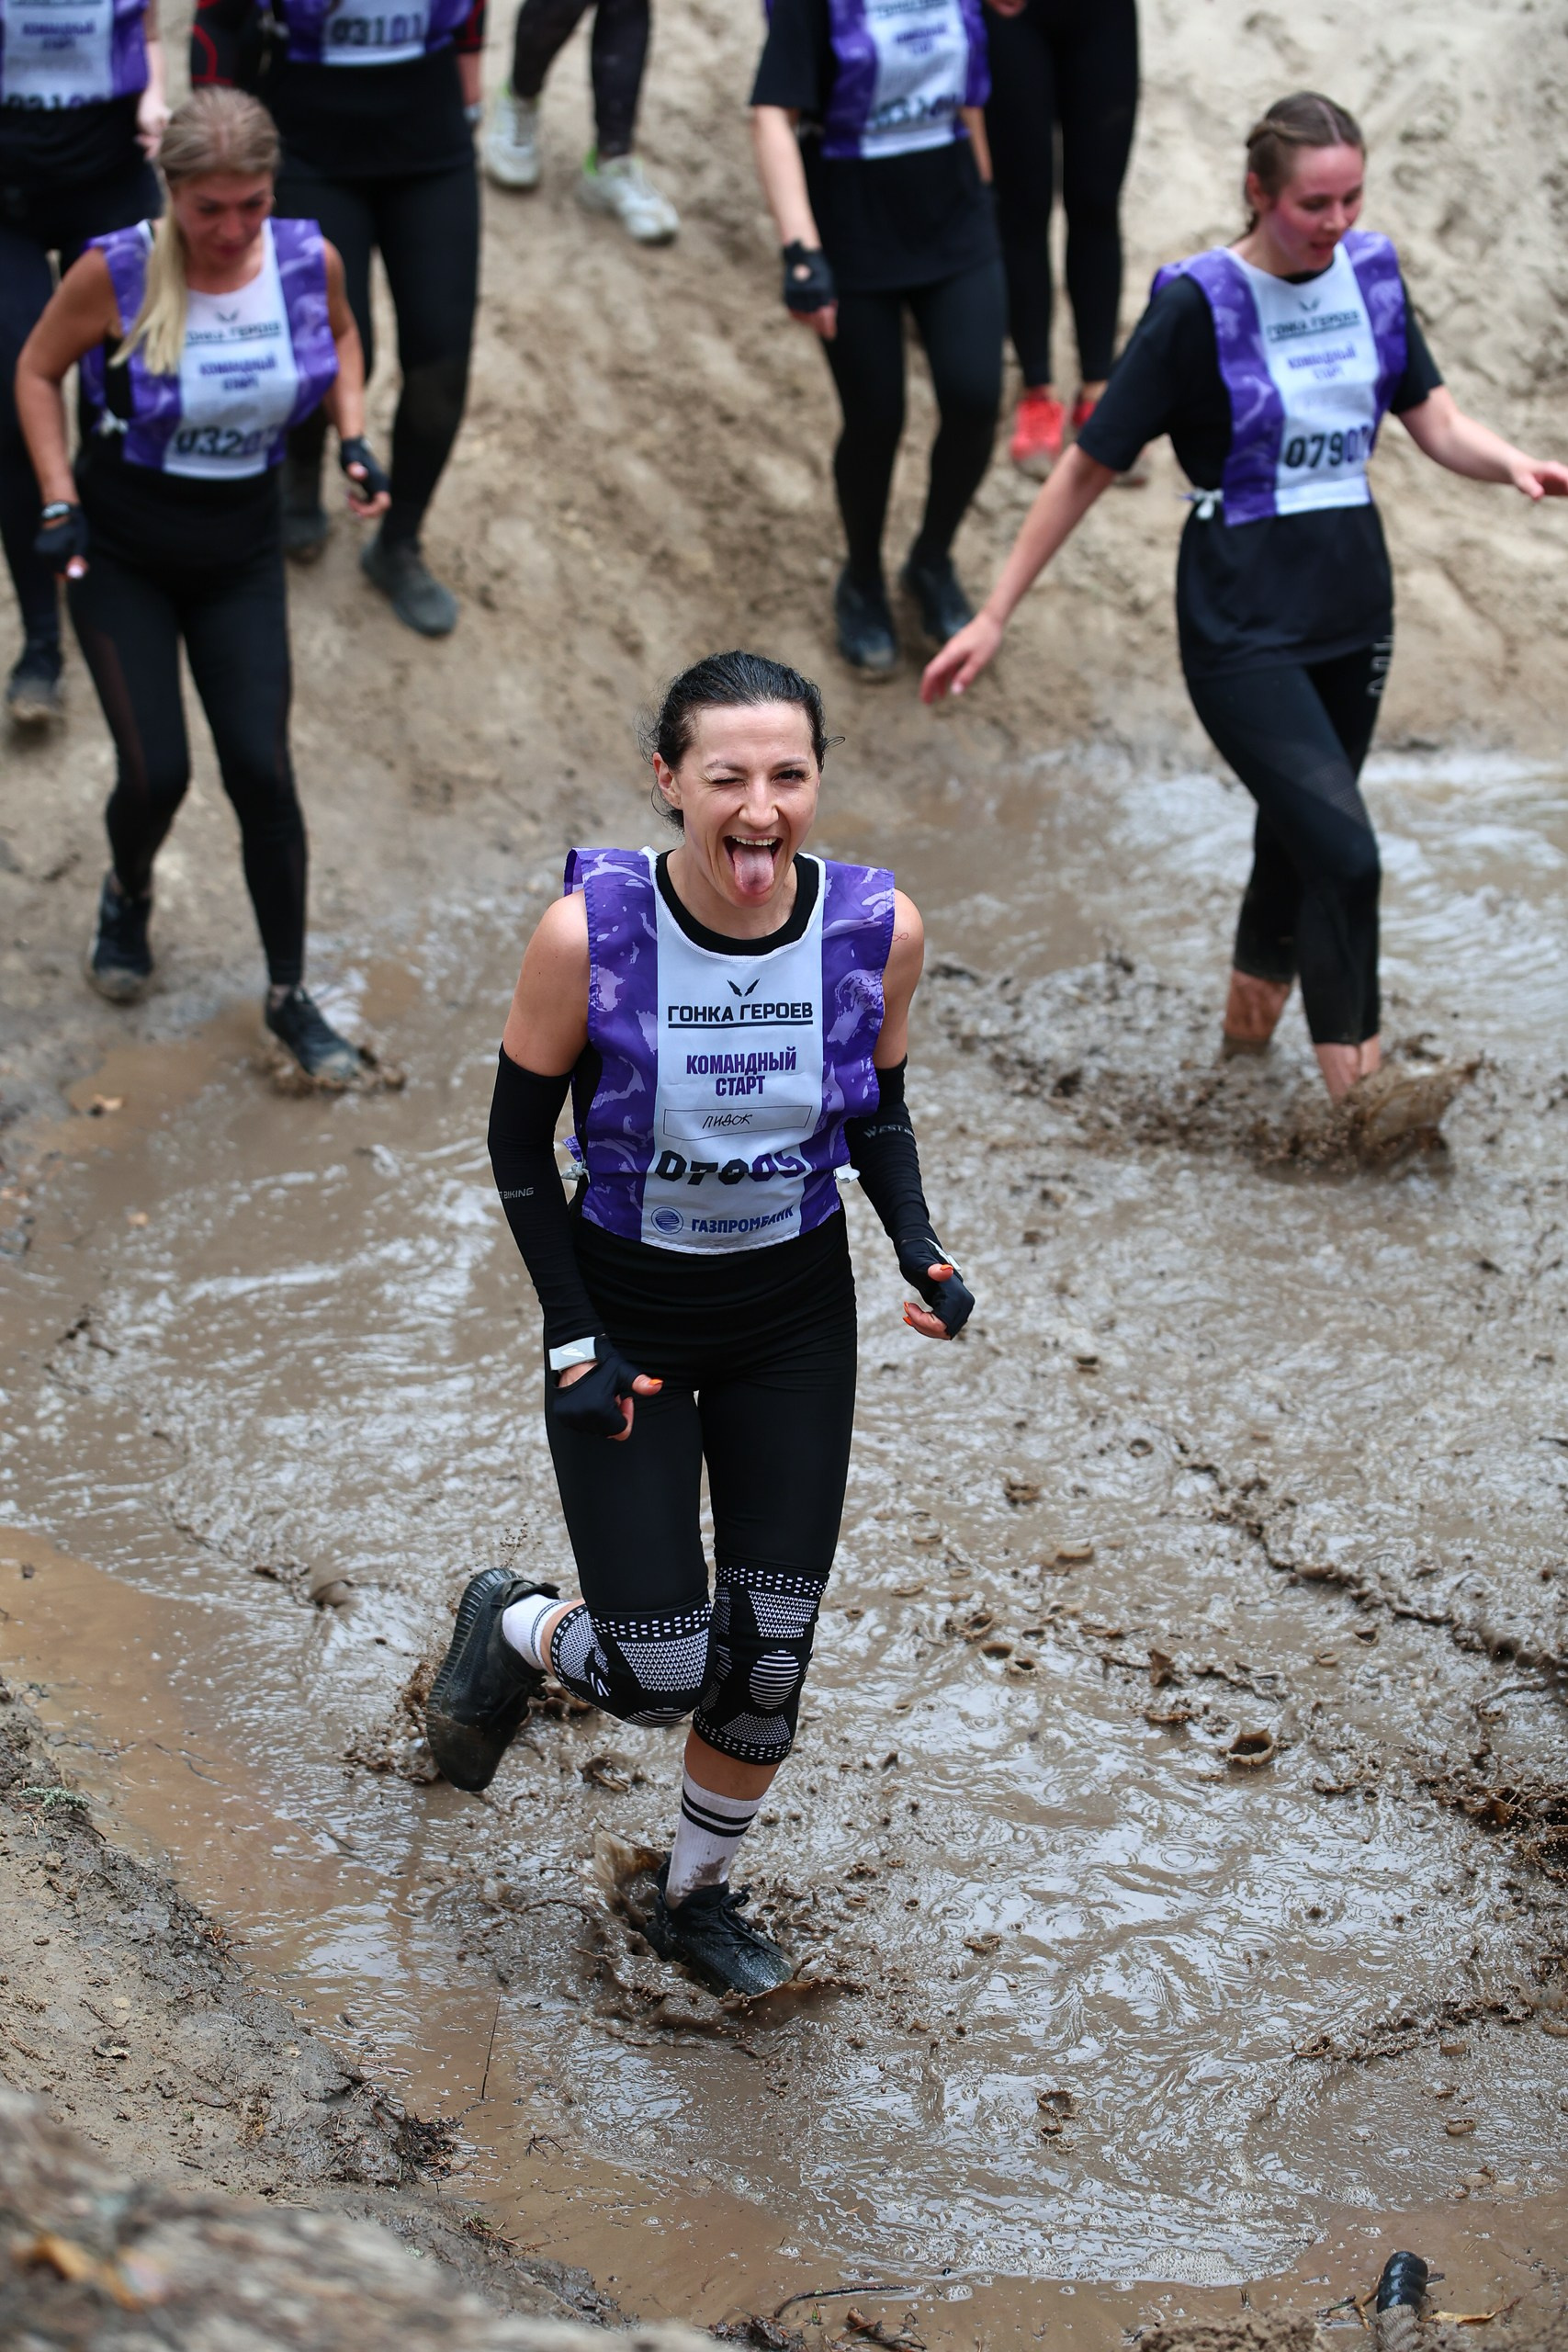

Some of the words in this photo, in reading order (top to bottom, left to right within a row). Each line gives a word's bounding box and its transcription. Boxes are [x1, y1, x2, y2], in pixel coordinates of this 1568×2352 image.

[668, 1005, 734, 1022] ГОНКА
[739, 1001, 813, 1021] ГЕРОЕВ
[686, 1046, 796, 1076] КОМАНДНЫЙ
[716, 1075, 765, 1097] СТАРТ
[692, 1204, 795, 1234] ГАЗПРОМБАНК
